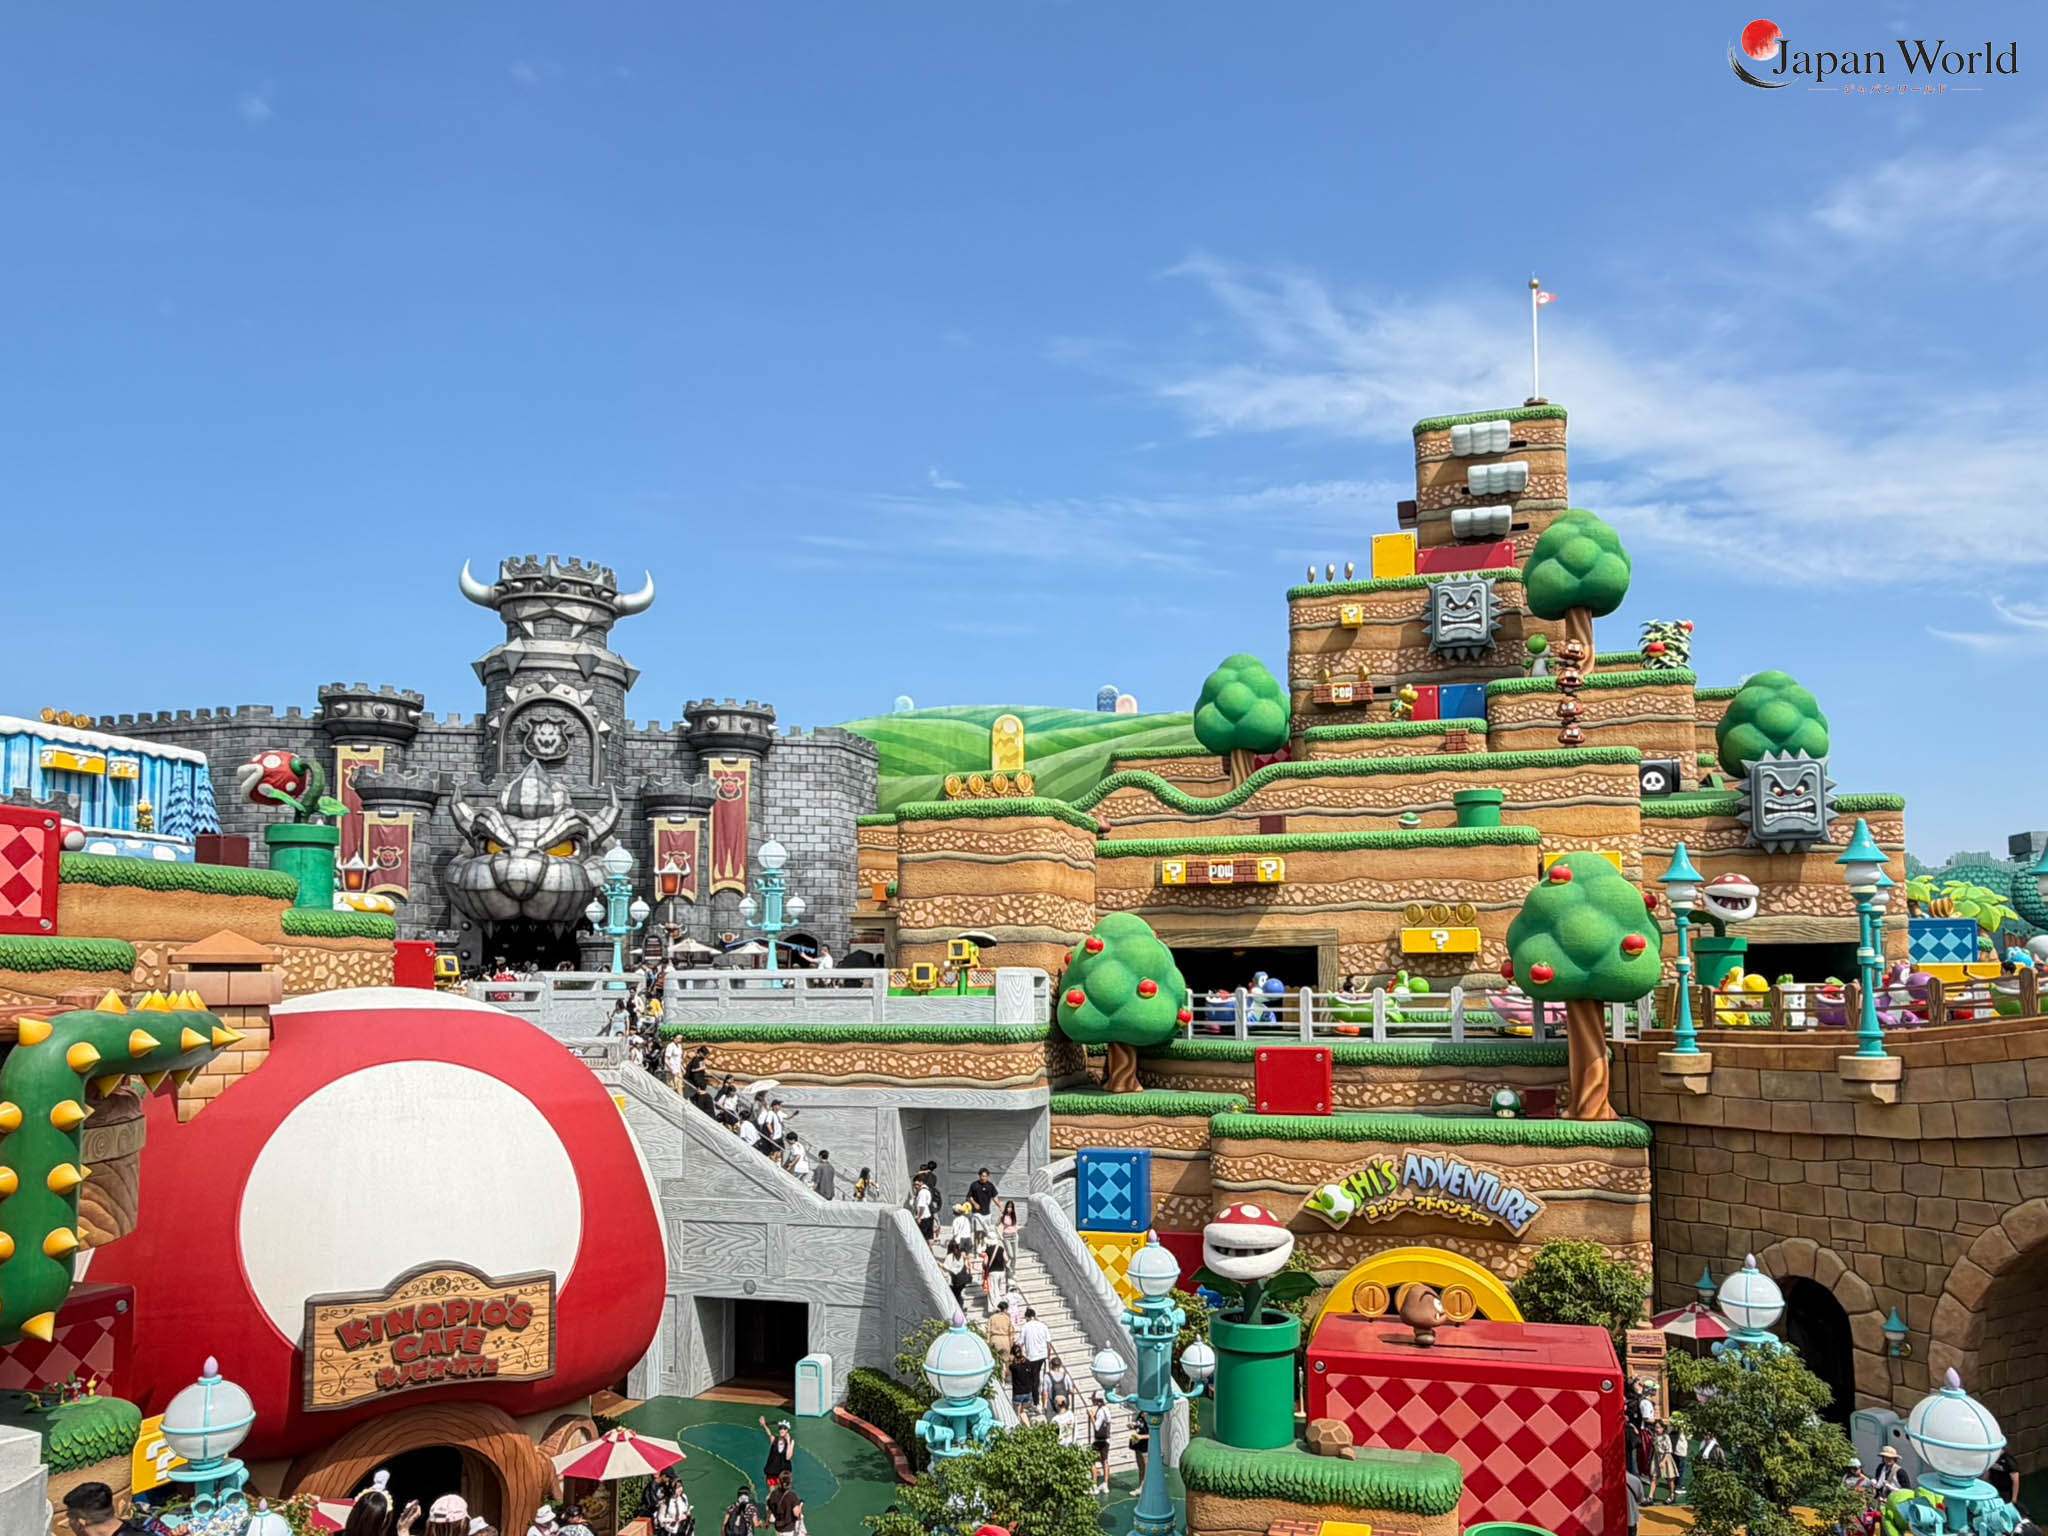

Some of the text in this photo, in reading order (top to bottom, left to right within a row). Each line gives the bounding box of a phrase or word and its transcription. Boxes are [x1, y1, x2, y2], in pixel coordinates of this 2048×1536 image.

[1208, 864, 1234, 879] POW
[1402, 1153, 1541, 1230] ADVENTURE
[336, 1294, 534, 1351] KINOPIO'S
[391, 1327, 487, 1363] CAFE
